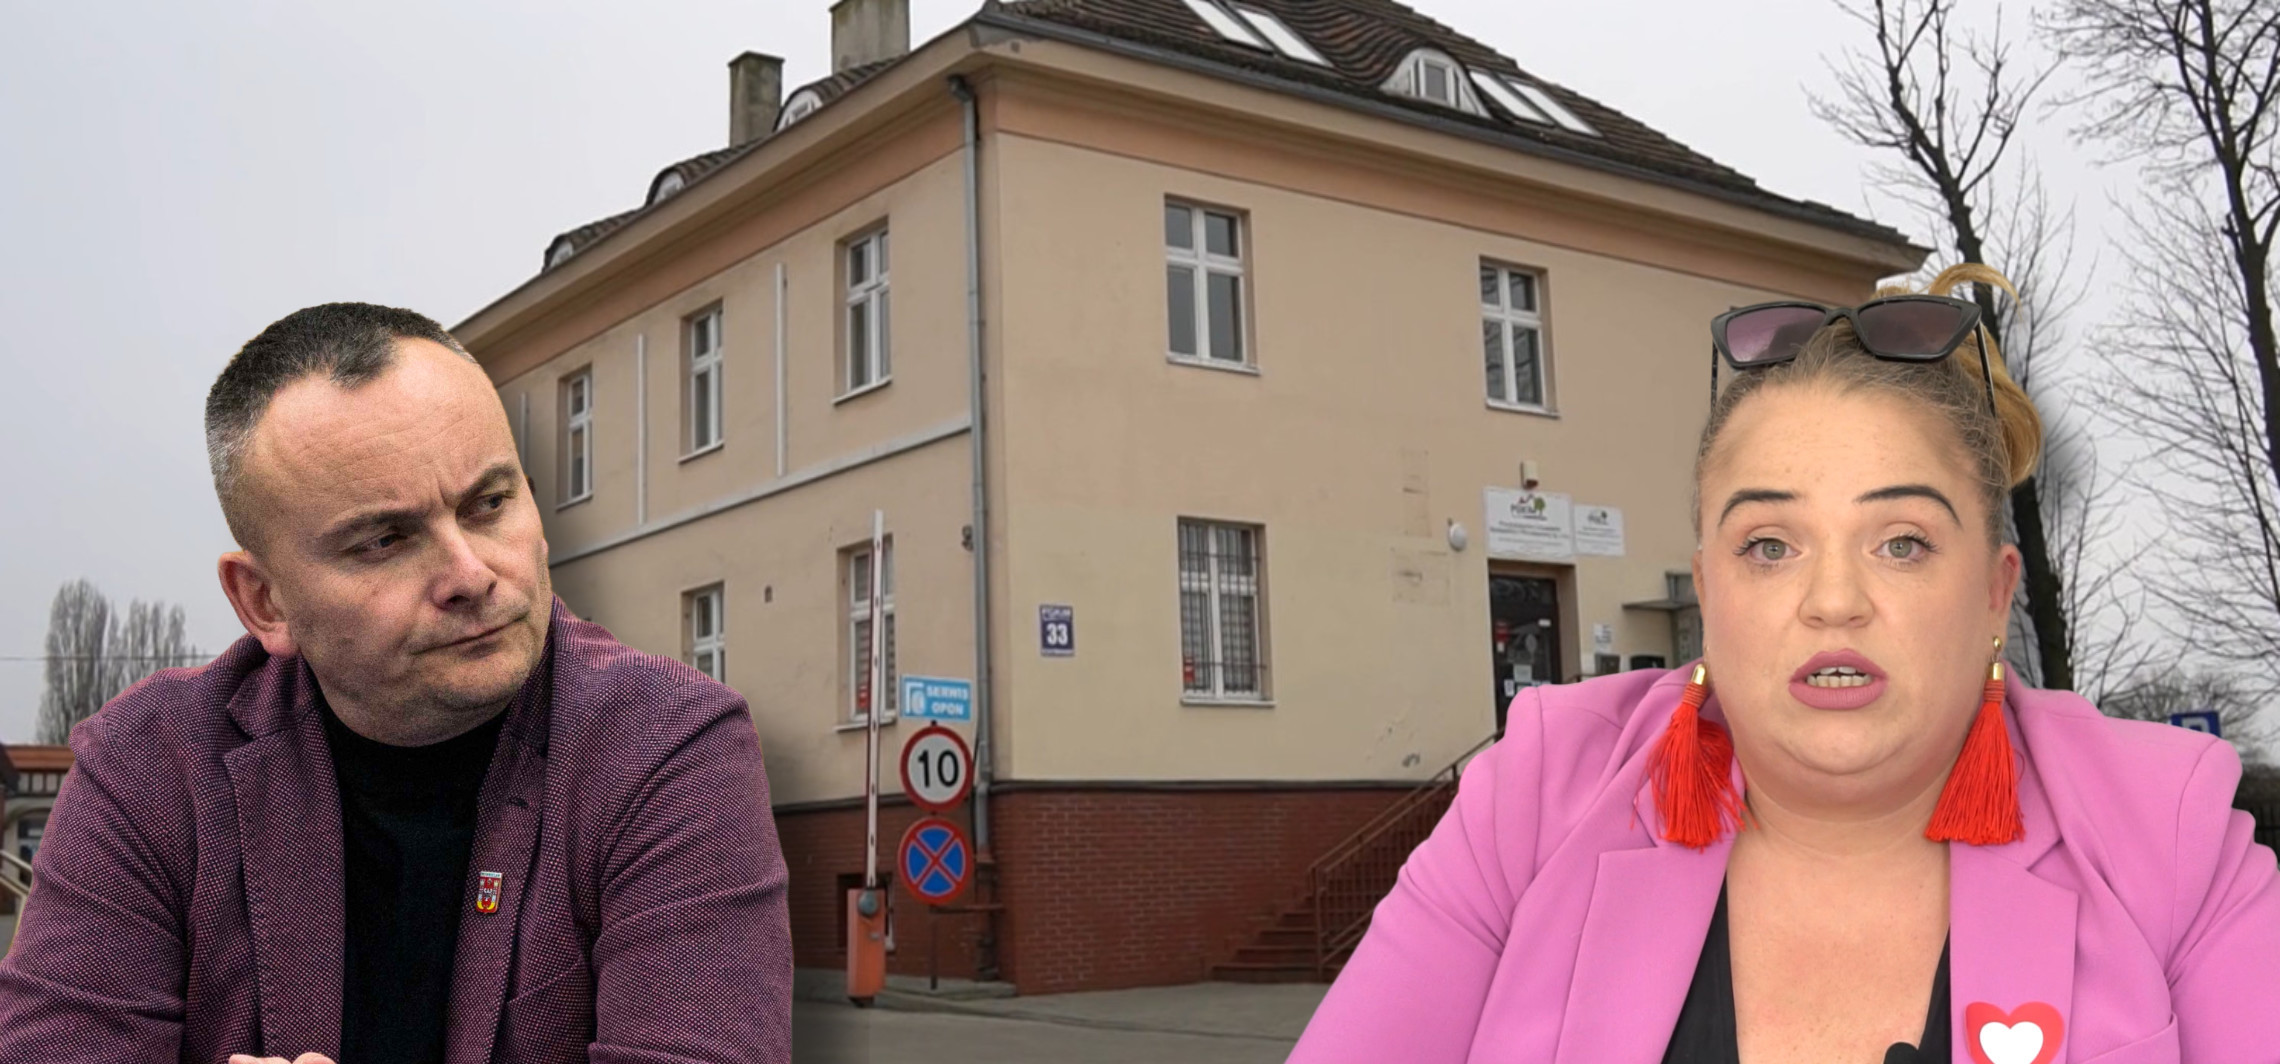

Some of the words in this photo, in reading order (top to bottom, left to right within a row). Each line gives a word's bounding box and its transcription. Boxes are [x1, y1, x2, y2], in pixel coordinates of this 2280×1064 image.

[1047, 623, 1068, 645] 33
[926, 684, 968, 700] SERWIS
[931, 701, 964, 716] OPON
[918, 749, 959, 788] 10
